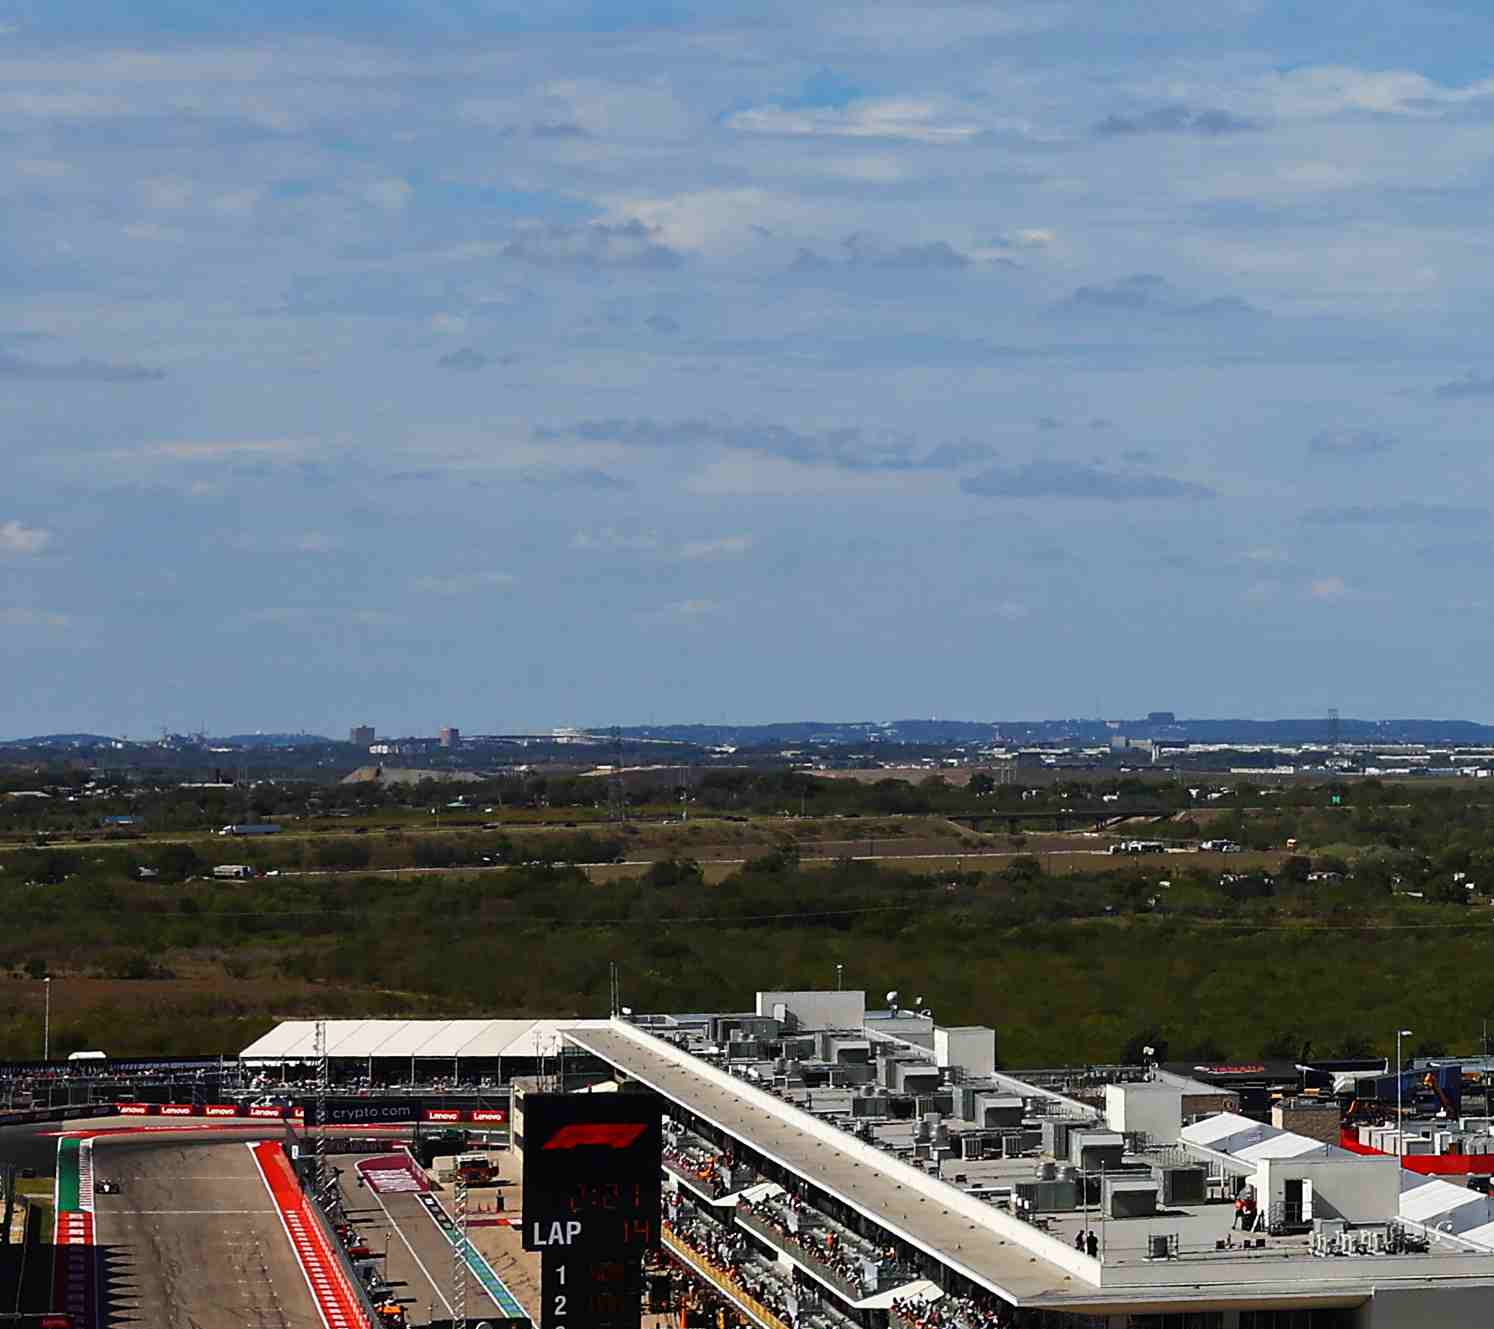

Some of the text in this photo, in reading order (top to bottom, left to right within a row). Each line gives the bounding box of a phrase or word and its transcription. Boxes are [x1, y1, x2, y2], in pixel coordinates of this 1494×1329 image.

[534, 1222, 581, 1245] LAP
[556, 1265, 565, 1284] 1
[555, 1296, 566, 1315] 2
